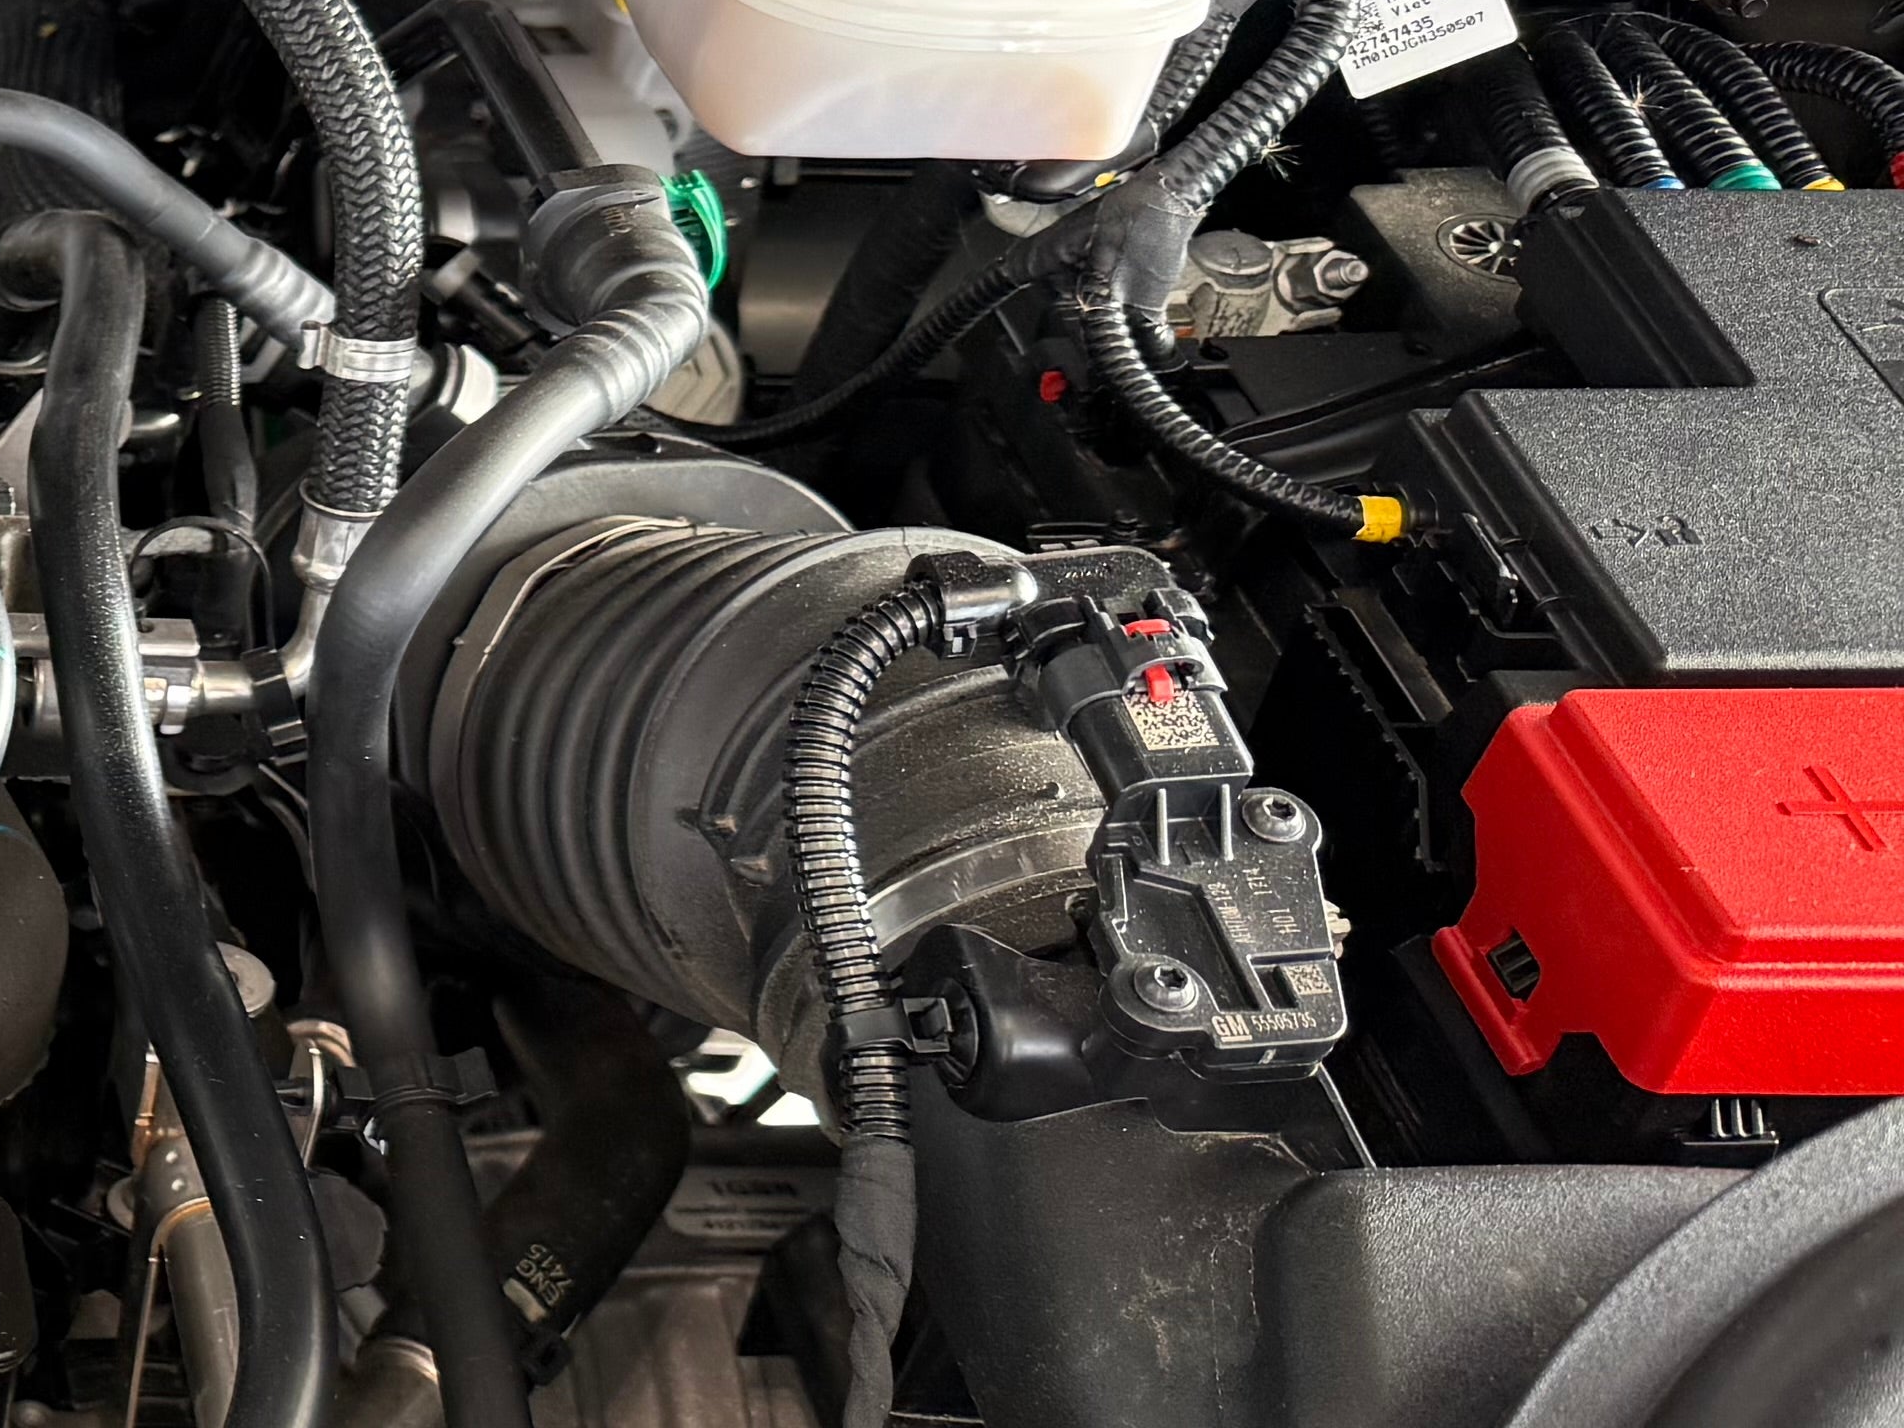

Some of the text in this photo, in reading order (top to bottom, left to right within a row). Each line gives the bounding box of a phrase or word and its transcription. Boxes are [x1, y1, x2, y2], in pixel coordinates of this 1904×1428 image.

[1347, 16, 1434, 57] 42747435
[1210, 1011, 1317, 1039] GM 55505735
